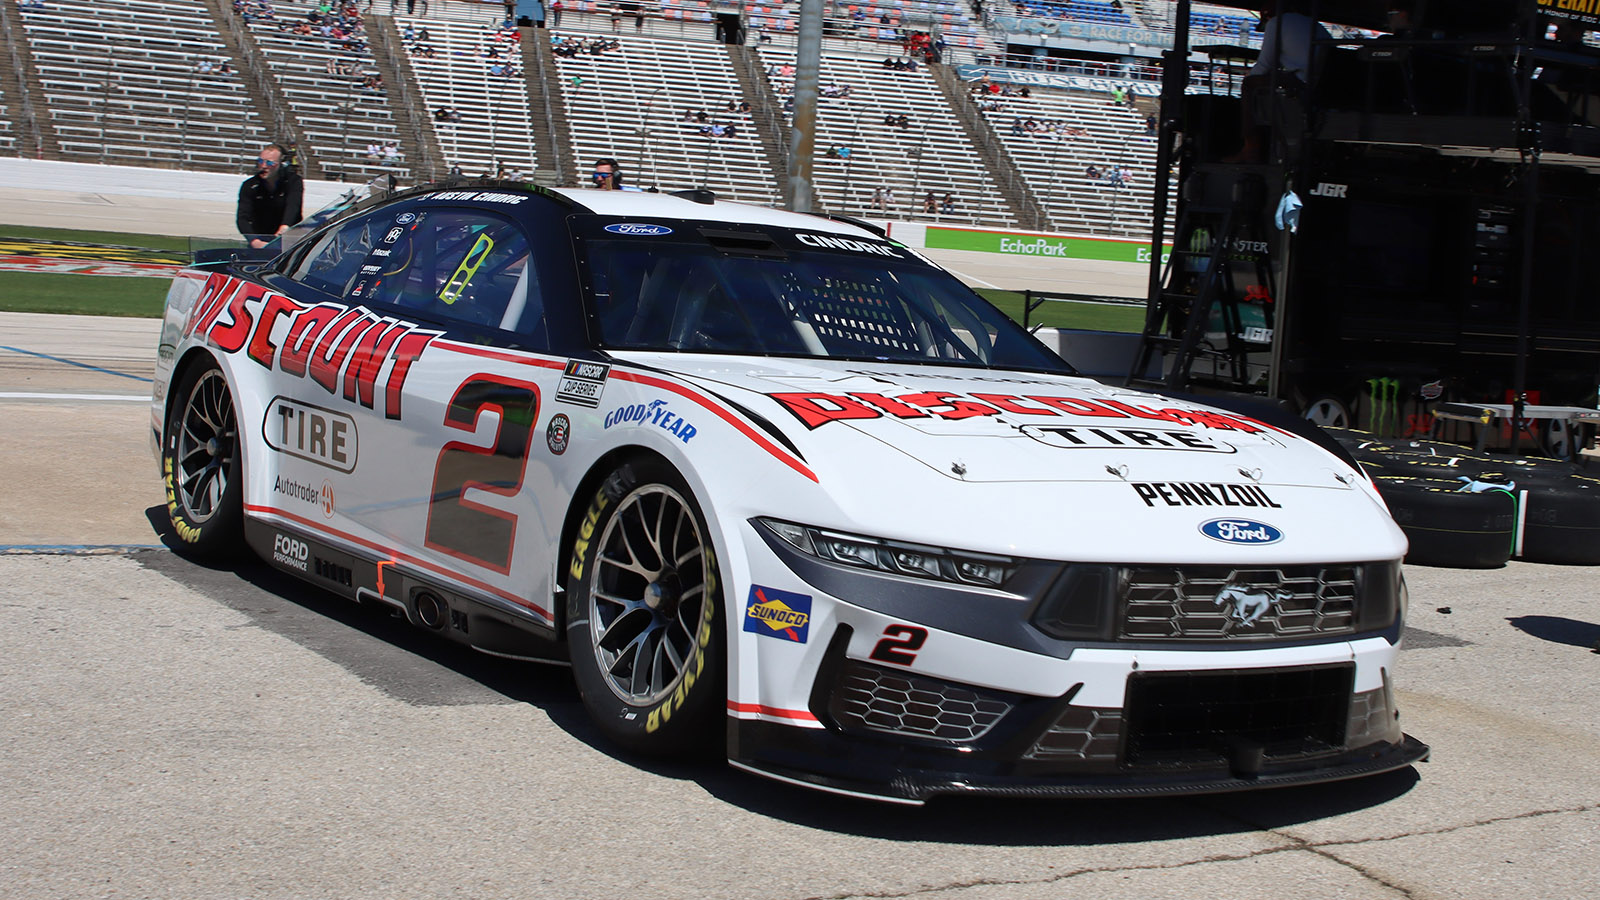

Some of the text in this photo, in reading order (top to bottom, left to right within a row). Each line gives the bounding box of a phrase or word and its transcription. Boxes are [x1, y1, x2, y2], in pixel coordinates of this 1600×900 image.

[1090, 27, 1122, 40] RACE
[1126, 29, 1152, 43] FOR
[1156, 32, 1173, 44] TH
[431, 191, 528, 205] AUSTIN CINDRIC
[1310, 183, 1348, 198] JGR
[795, 232, 905, 259] CINDRIC
[1000, 238, 1067, 256] EchoPark
[184, 271, 446, 421] DISCOUNT
[577, 363, 604, 379] NASCAR
[564, 381, 598, 396] CUP SERIES
[604, 400, 697, 444] GOODYEAR
[765, 391, 1296, 438] DISCOUNT
[278, 404, 347, 464] TIRE
[1038, 428, 1217, 449] TIRE
[424, 372, 541, 576] 2
[274, 474, 319, 504] Autotrader
[1131, 483, 1282, 508] PENNZOIL
[274, 533, 309, 561] FORD
[570, 486, 611, 582] EAGLE
[273, 552, 308, 572] PERFORMANCE
[750, 604, 806, 626] SUNOCO
[868, 623, 929, 667] 2
